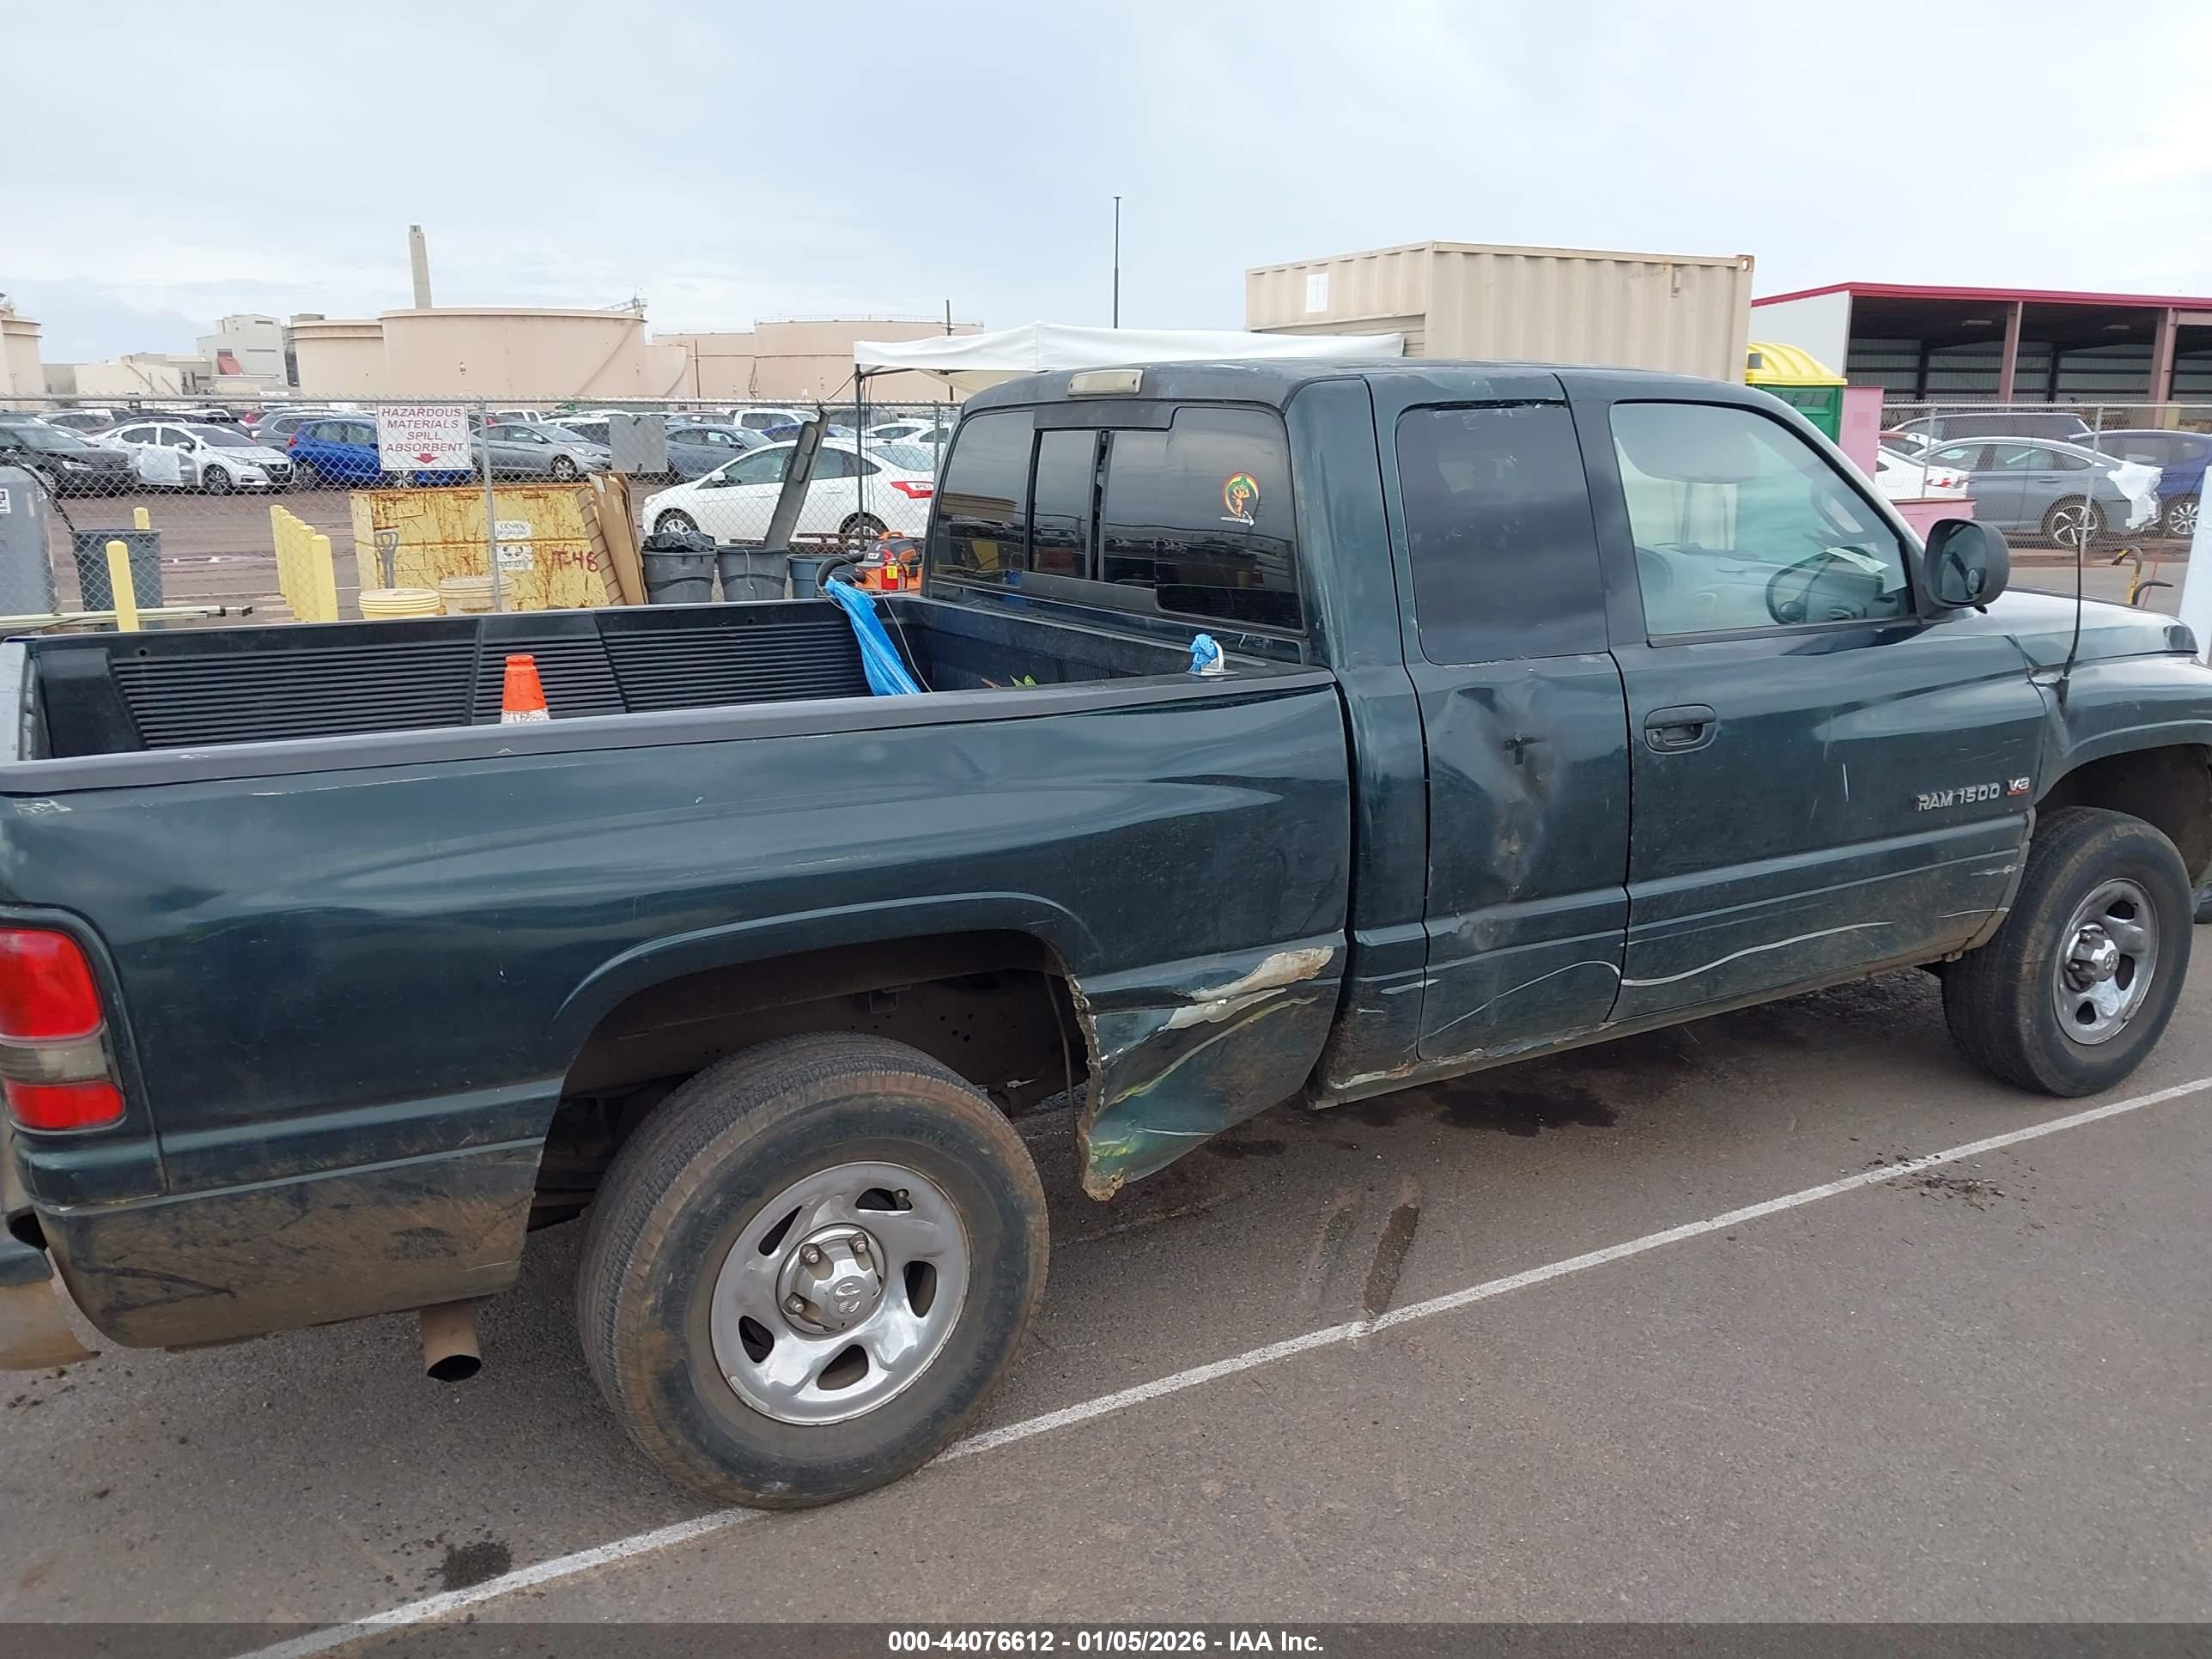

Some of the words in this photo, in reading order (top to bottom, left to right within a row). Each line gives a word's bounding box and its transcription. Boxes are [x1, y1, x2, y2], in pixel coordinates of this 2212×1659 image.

[382, 408, 461, 417] HAZARDOUS
[387, 420, 459, 428] MATERIALS
[407, 431, 442, 441] SPILL
[385, 442, 465, 453] ABSORBENT
[1917, 790, 1954, 811] RAM
[1953, 782, 2001, 805] 1500
[2007, 776, 2030, 792] V8
